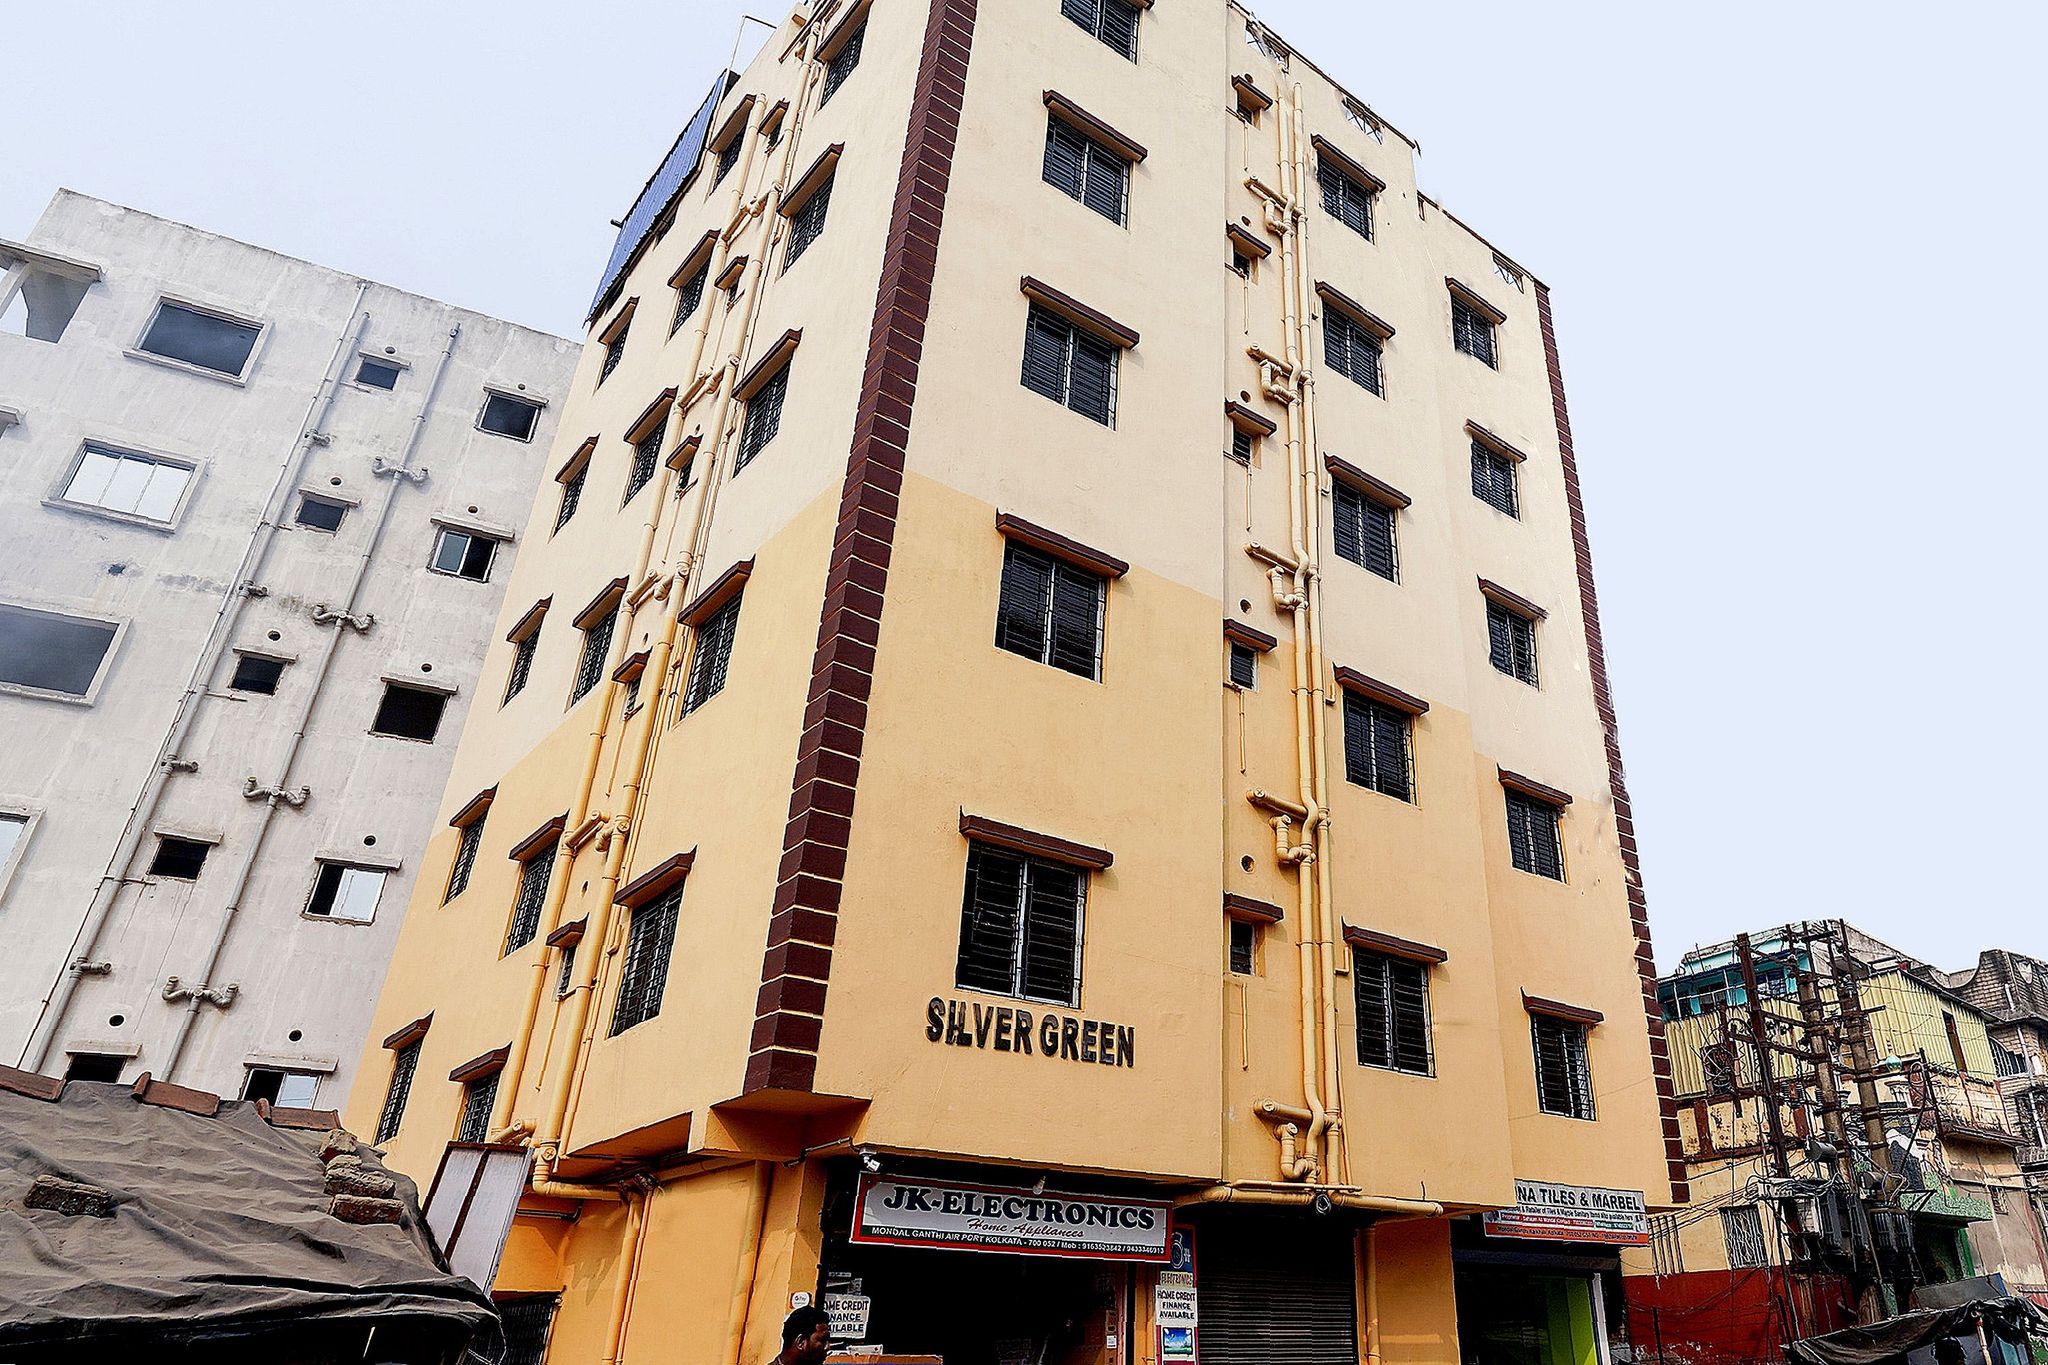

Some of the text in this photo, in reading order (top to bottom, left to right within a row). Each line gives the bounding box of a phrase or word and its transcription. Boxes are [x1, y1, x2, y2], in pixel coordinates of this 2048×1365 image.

[925, 996, 1134, 1067] SILVER GREEN
[1540, 1188, 1578, 1206] TILES
[1580, 1192, 1589, 1207] &
[1592, 1193, 1640, 1211] MARBEL
[883, 1186, 1155, 1230] JK-ELECTRONICS
[967, 1218, 1084, 1238] Home Appliances
[872, 1227, 908, 1237] MONDAL
[961, 1234, 983, 1242] PORT
[985, 1235, 1022, 1246] KOLKATA
[1157, 1289, 1196, 1301] HOME CREDIT
[824, 1300, 869, 1311] OME CREDIT
[829, 1312, 861, 1322] NANCE
[1159, 1310, 1194, 1320] AVAILABLE
[827, 1323, 864, 1332] AILABLE
